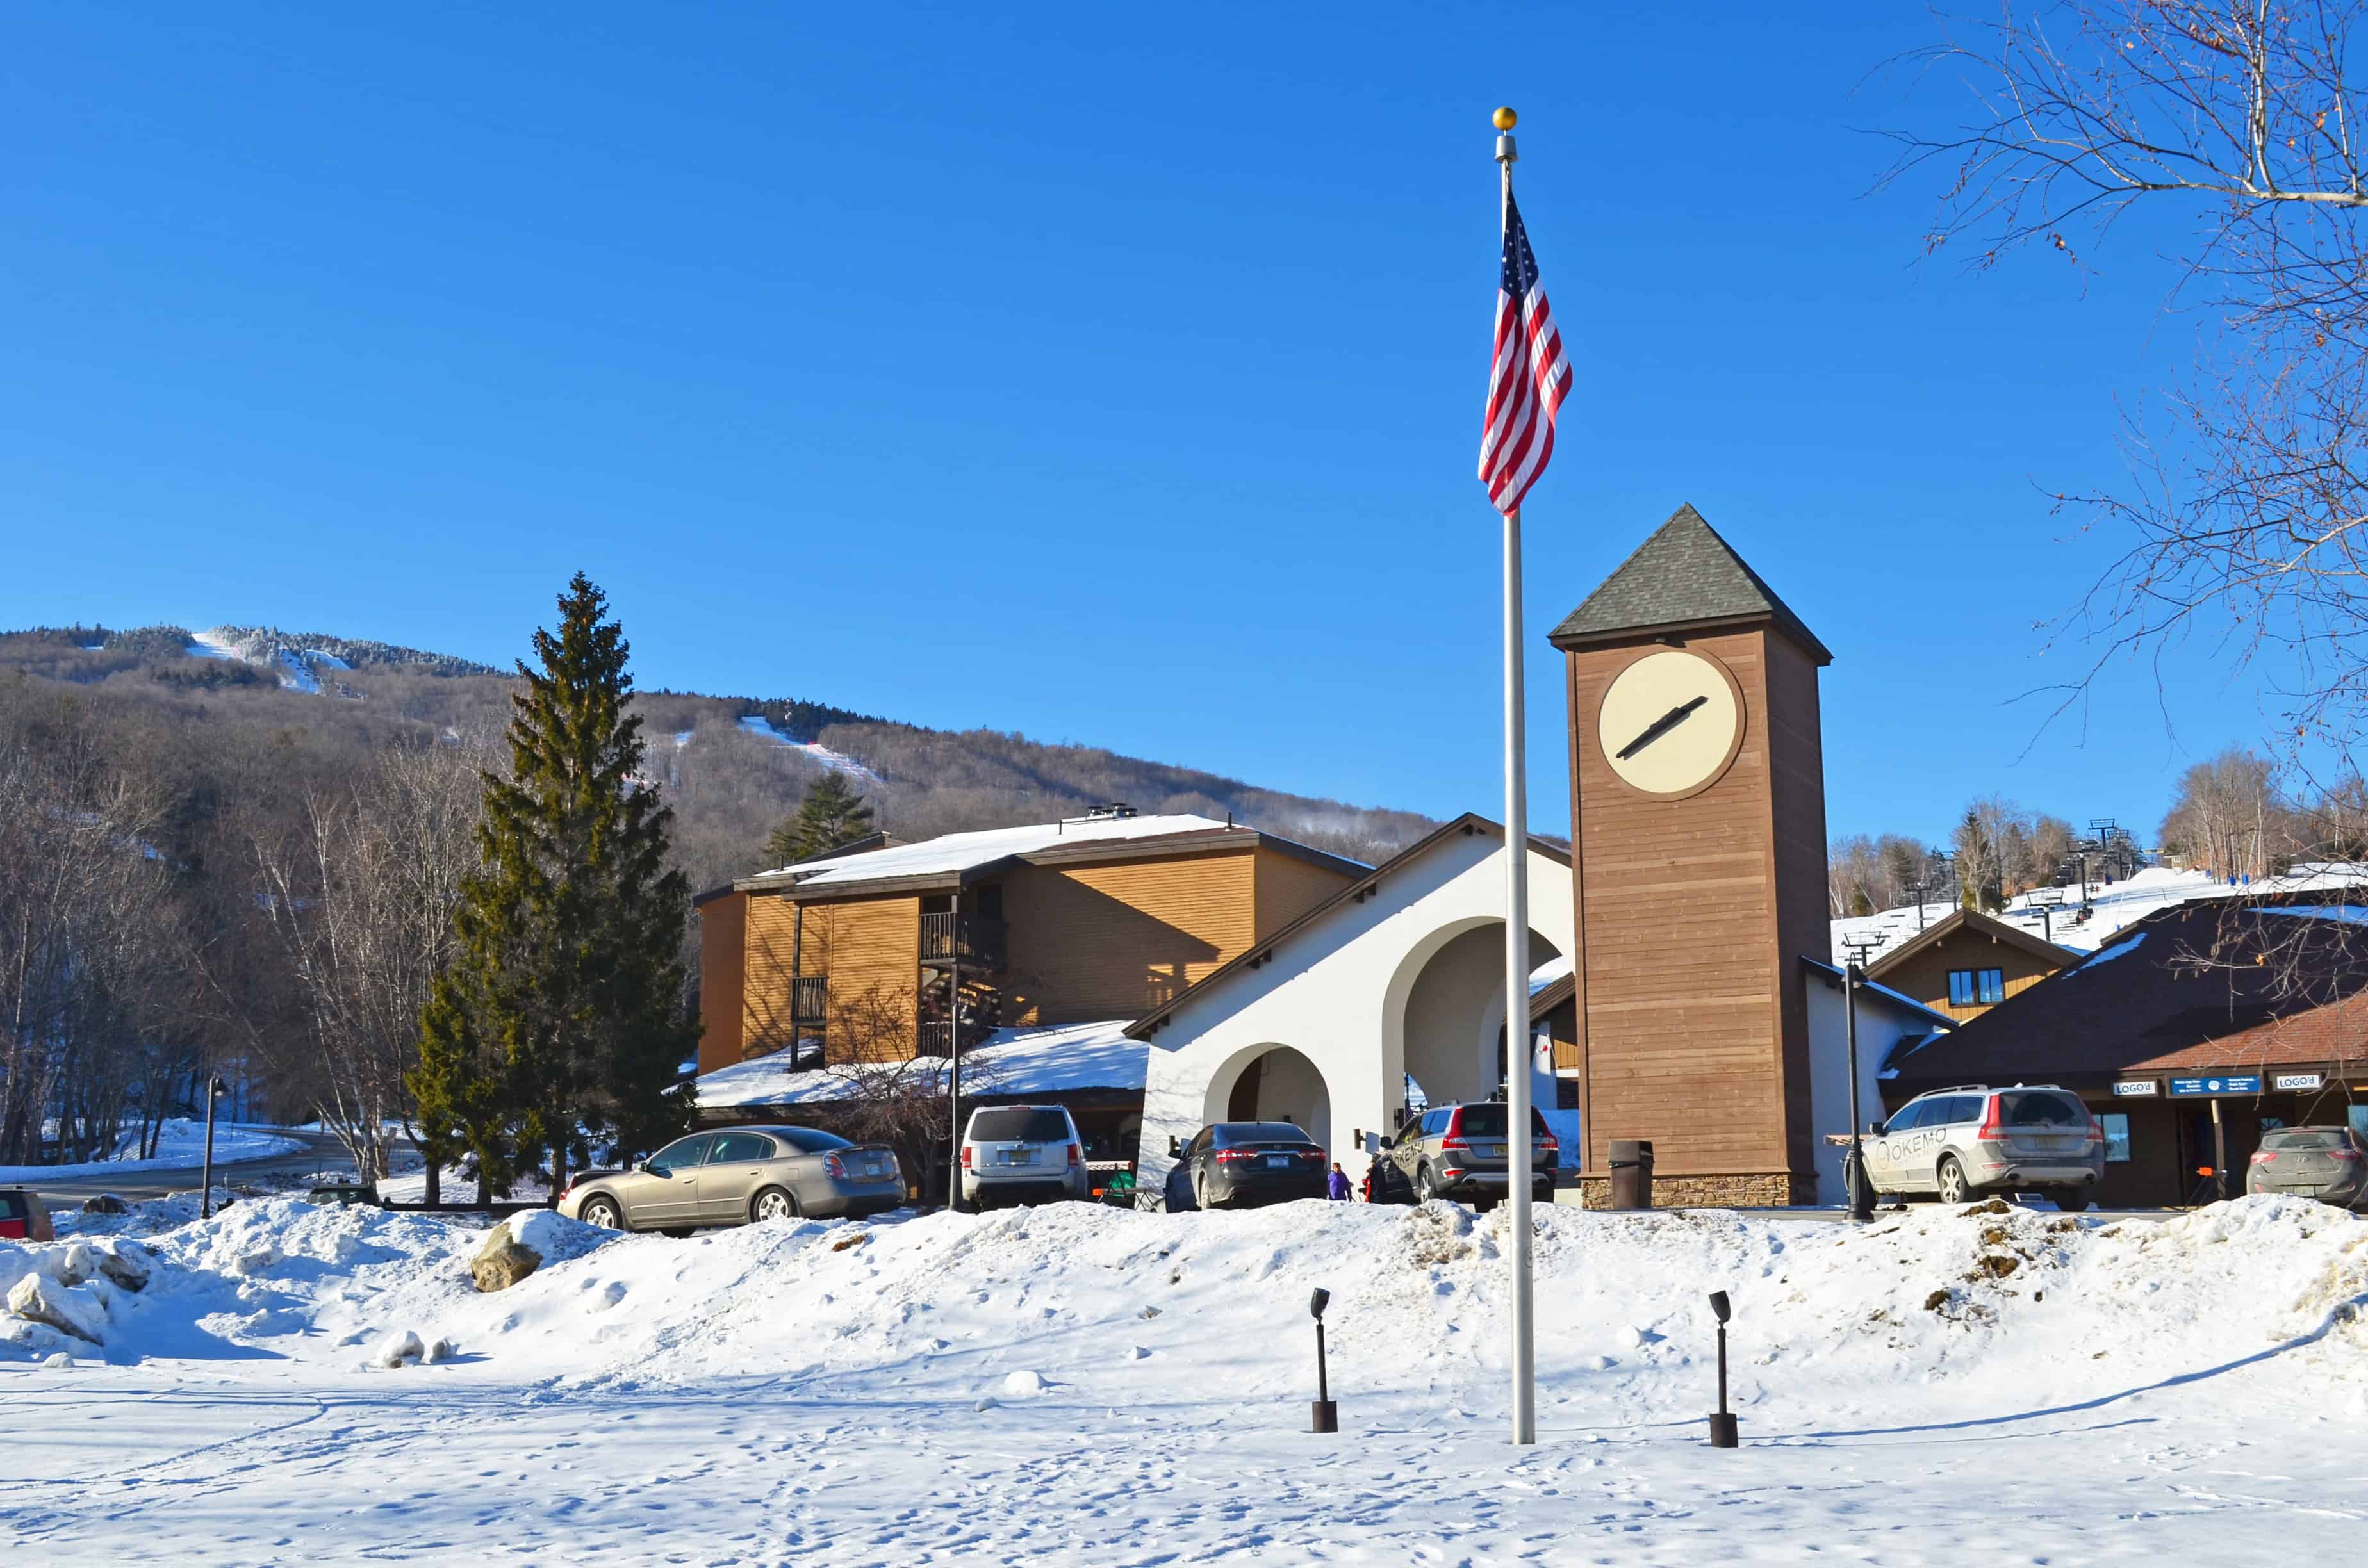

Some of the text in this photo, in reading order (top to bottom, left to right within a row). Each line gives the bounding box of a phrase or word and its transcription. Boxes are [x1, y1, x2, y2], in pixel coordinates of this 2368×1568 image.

[2280, 1076, 2314, 1087] LOGO'd
[2116, 1083, 2151, 1093] LOGO'd
[1892, 1128, 1946, 1161] OKEMO
